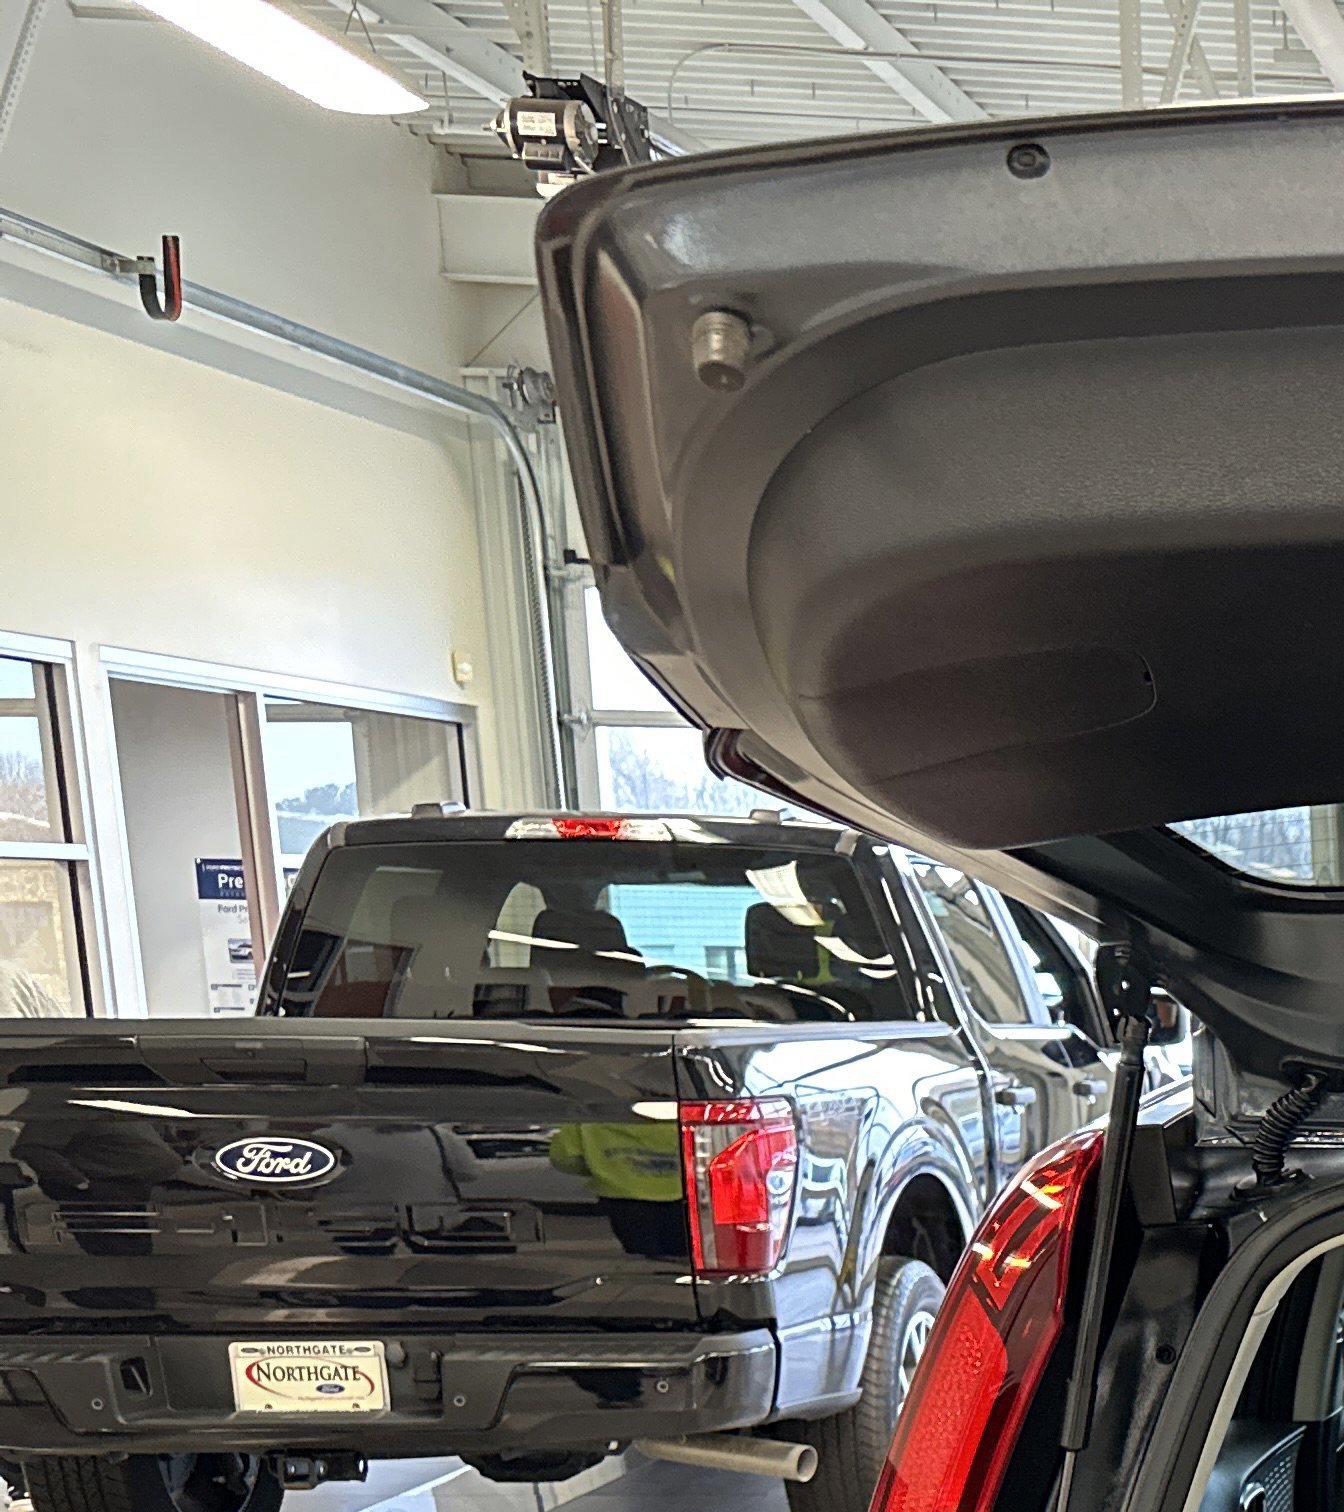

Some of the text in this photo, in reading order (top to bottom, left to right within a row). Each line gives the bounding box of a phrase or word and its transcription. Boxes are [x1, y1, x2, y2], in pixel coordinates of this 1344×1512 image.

[236, 1143, 312, 1173] Ford
[266, 1344, 347, 1356] NORTHGATE
[255, 1362, 361, 1383] NORTHGATE
